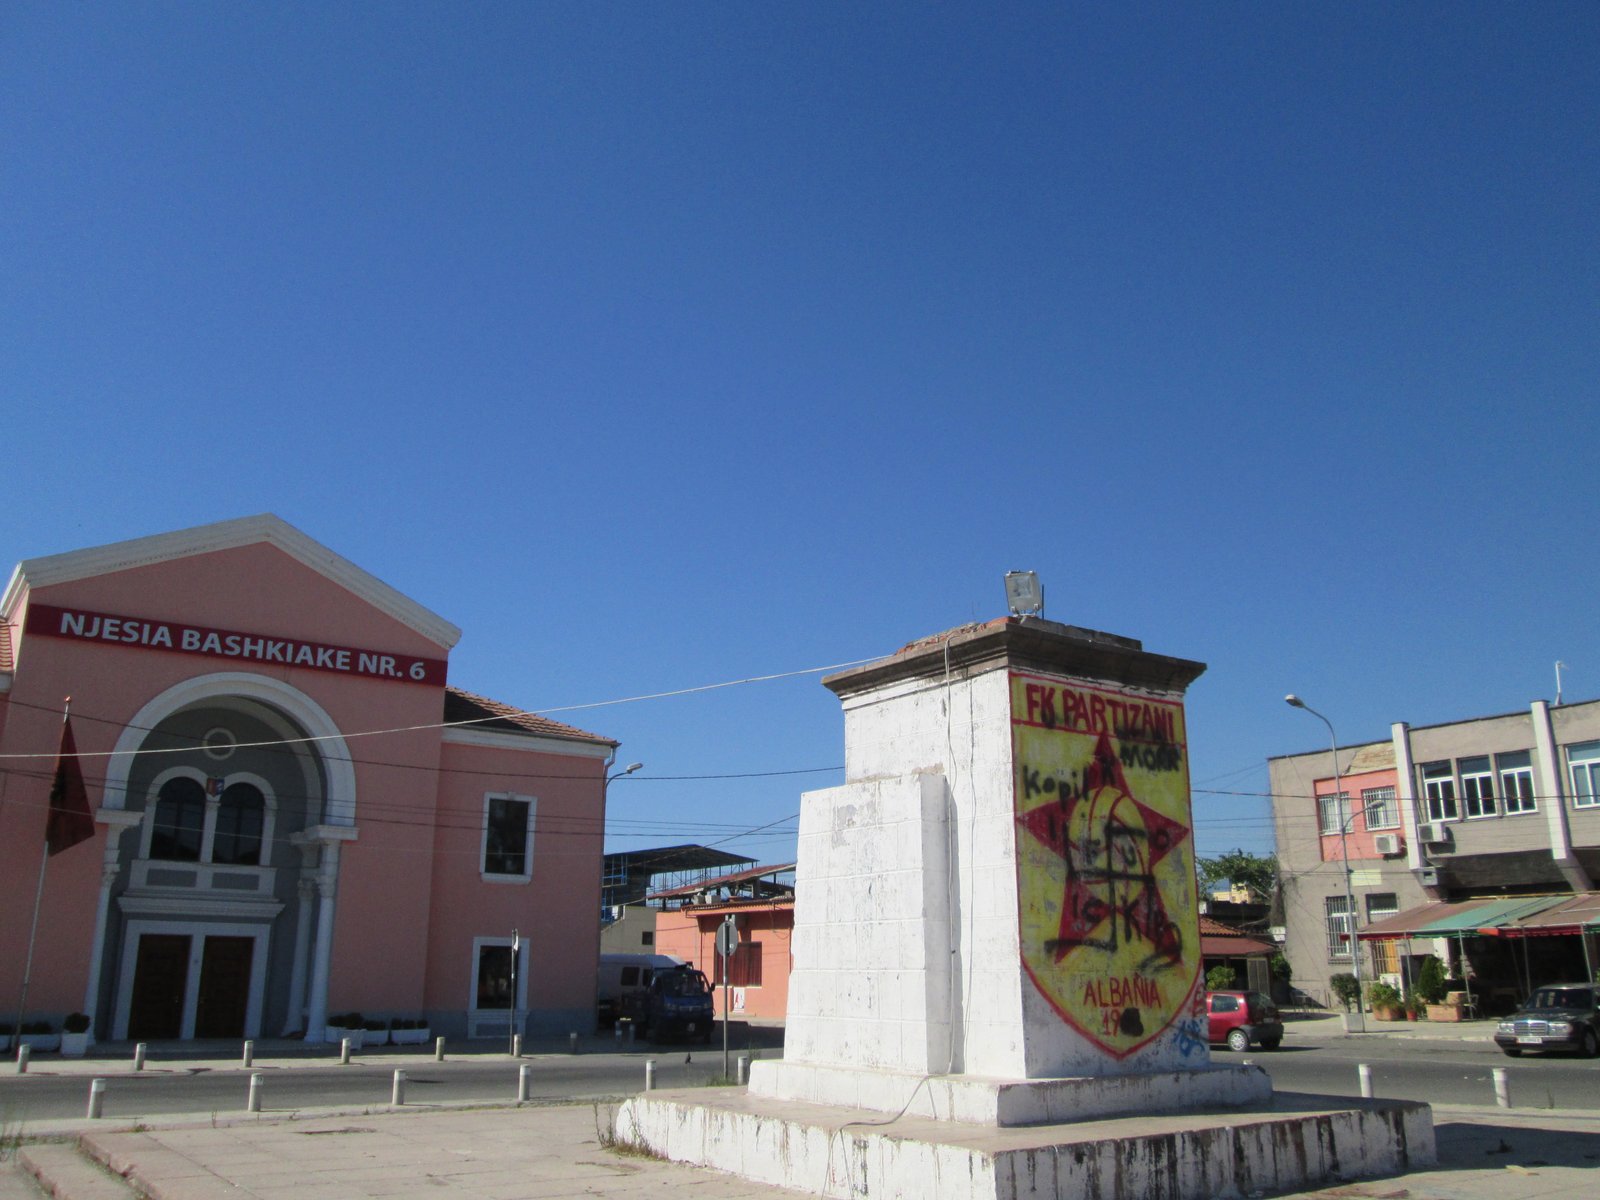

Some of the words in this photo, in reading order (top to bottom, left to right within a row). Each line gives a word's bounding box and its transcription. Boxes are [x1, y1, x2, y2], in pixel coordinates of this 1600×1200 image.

[60, 612, 172, 648] NJESIA
[180, 631, 351, 668] BASHKIAKE
[357, 653, 404, 677] NR.
[409, 663, 426, 680] 6
[1026, 684, 1055, 725] FK
[1062, 690, 1174, 742] PARTIZANI
